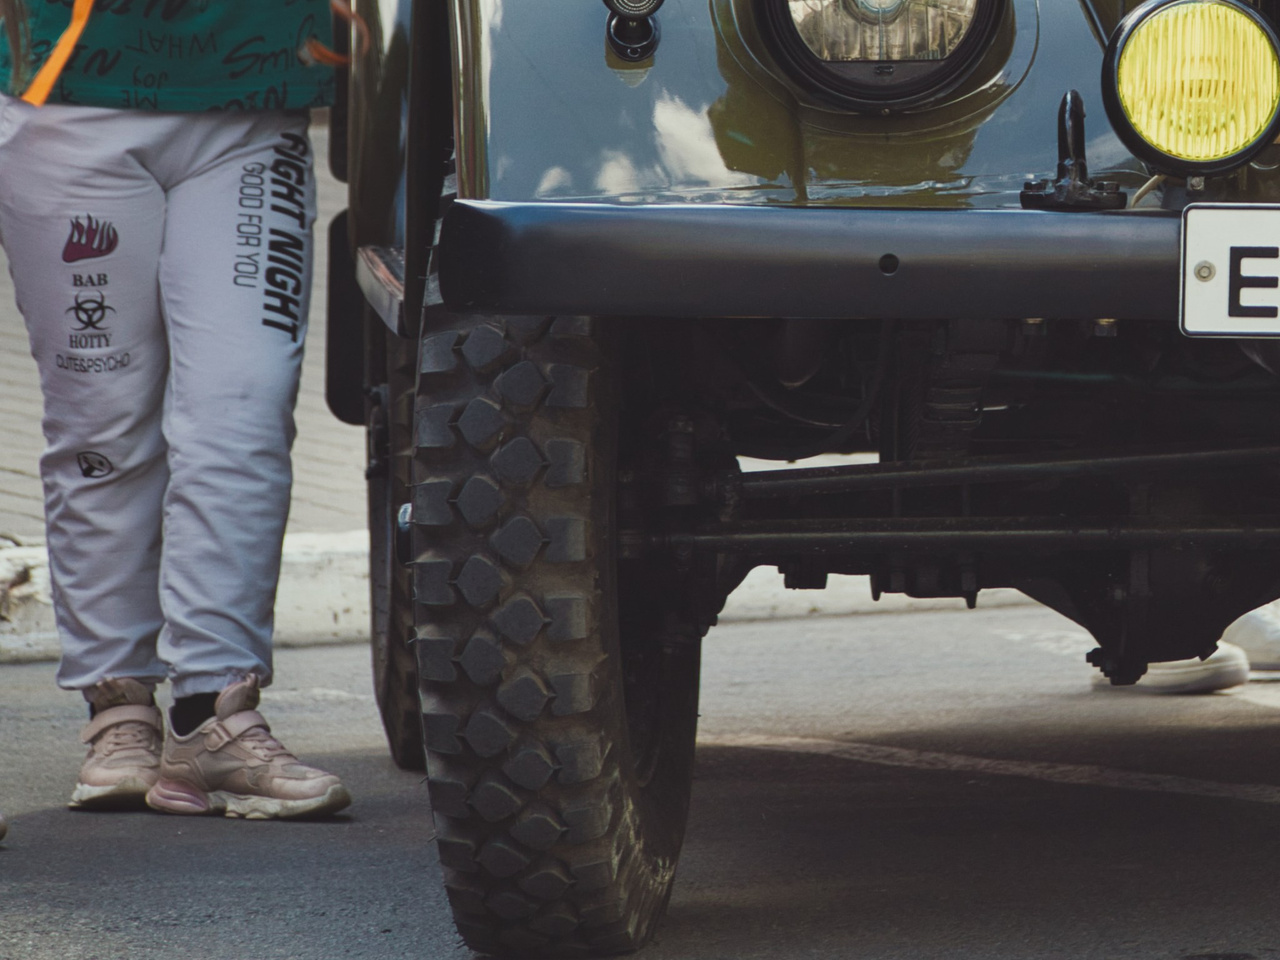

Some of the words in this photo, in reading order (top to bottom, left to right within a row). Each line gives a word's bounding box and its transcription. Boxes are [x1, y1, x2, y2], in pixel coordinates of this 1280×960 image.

[239, 162, 266, 209] GOOD
[237, 213, 262, 247] FOR
[72, 273, 108, 287] BAB
[233, 252, 260, 288] YOU
[261, 228, 304, 343] NIGHT
[69, 334, 112, 349] HOTTY
